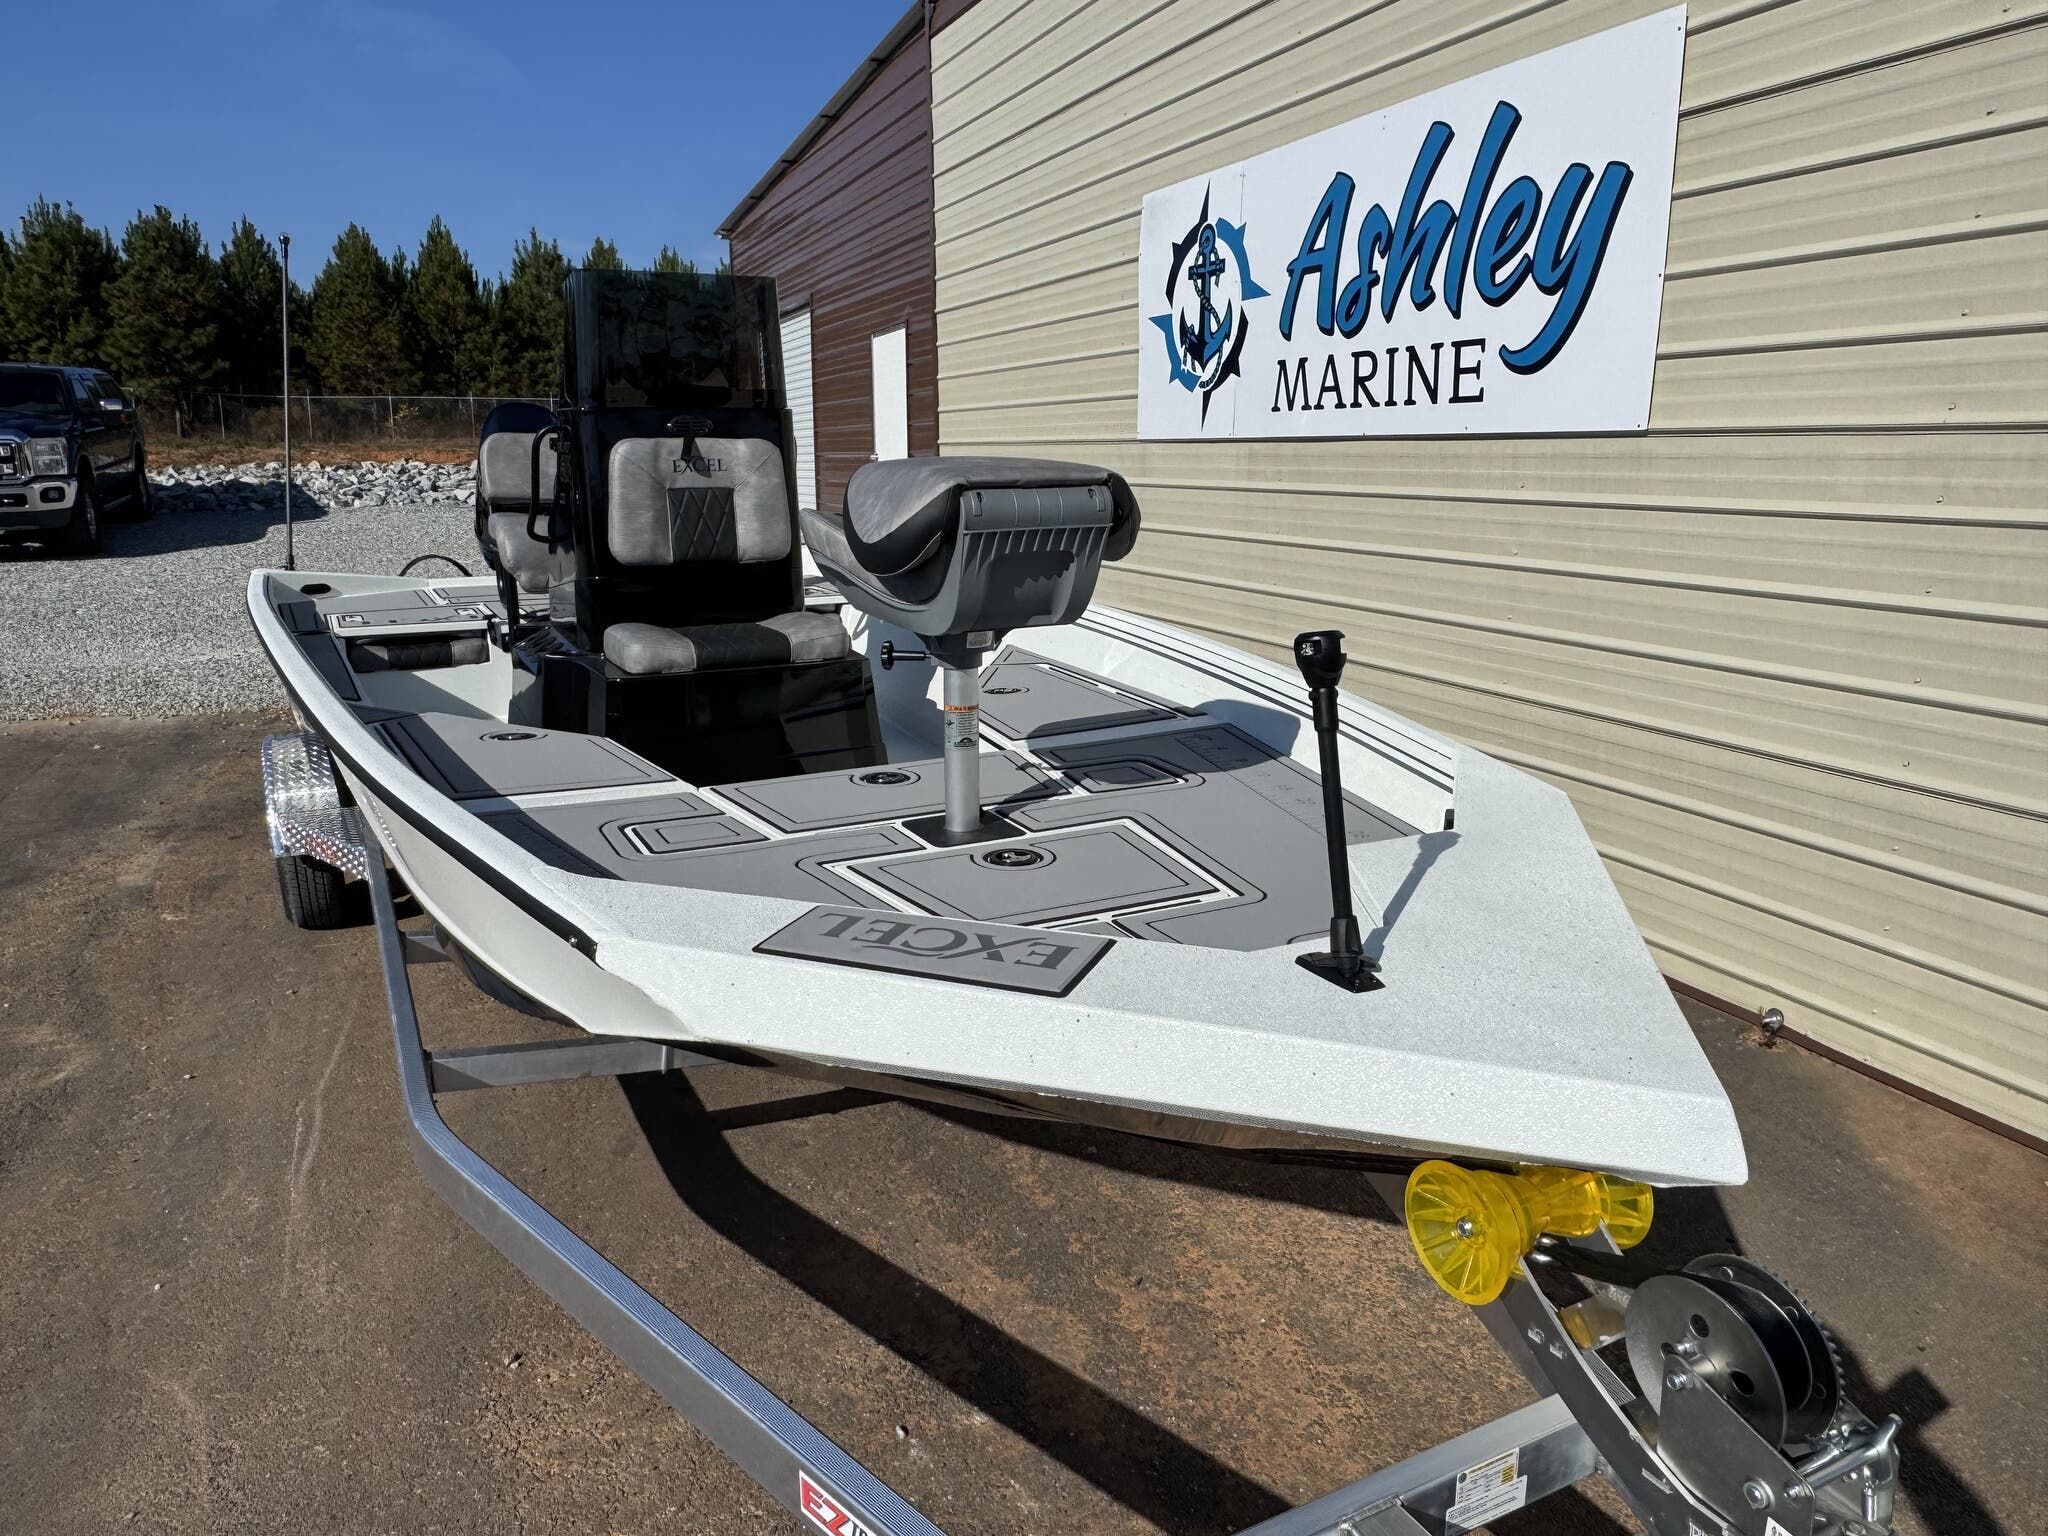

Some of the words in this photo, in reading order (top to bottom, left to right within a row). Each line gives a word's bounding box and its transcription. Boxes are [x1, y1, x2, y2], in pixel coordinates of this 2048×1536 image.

[1279, 100, 1634, 375] Ashley
[1271, 338, 1486, 412] MARINE
[672, 456, 727, 474] EXCEL
[818, 912, 1080, 969] EXCEL
